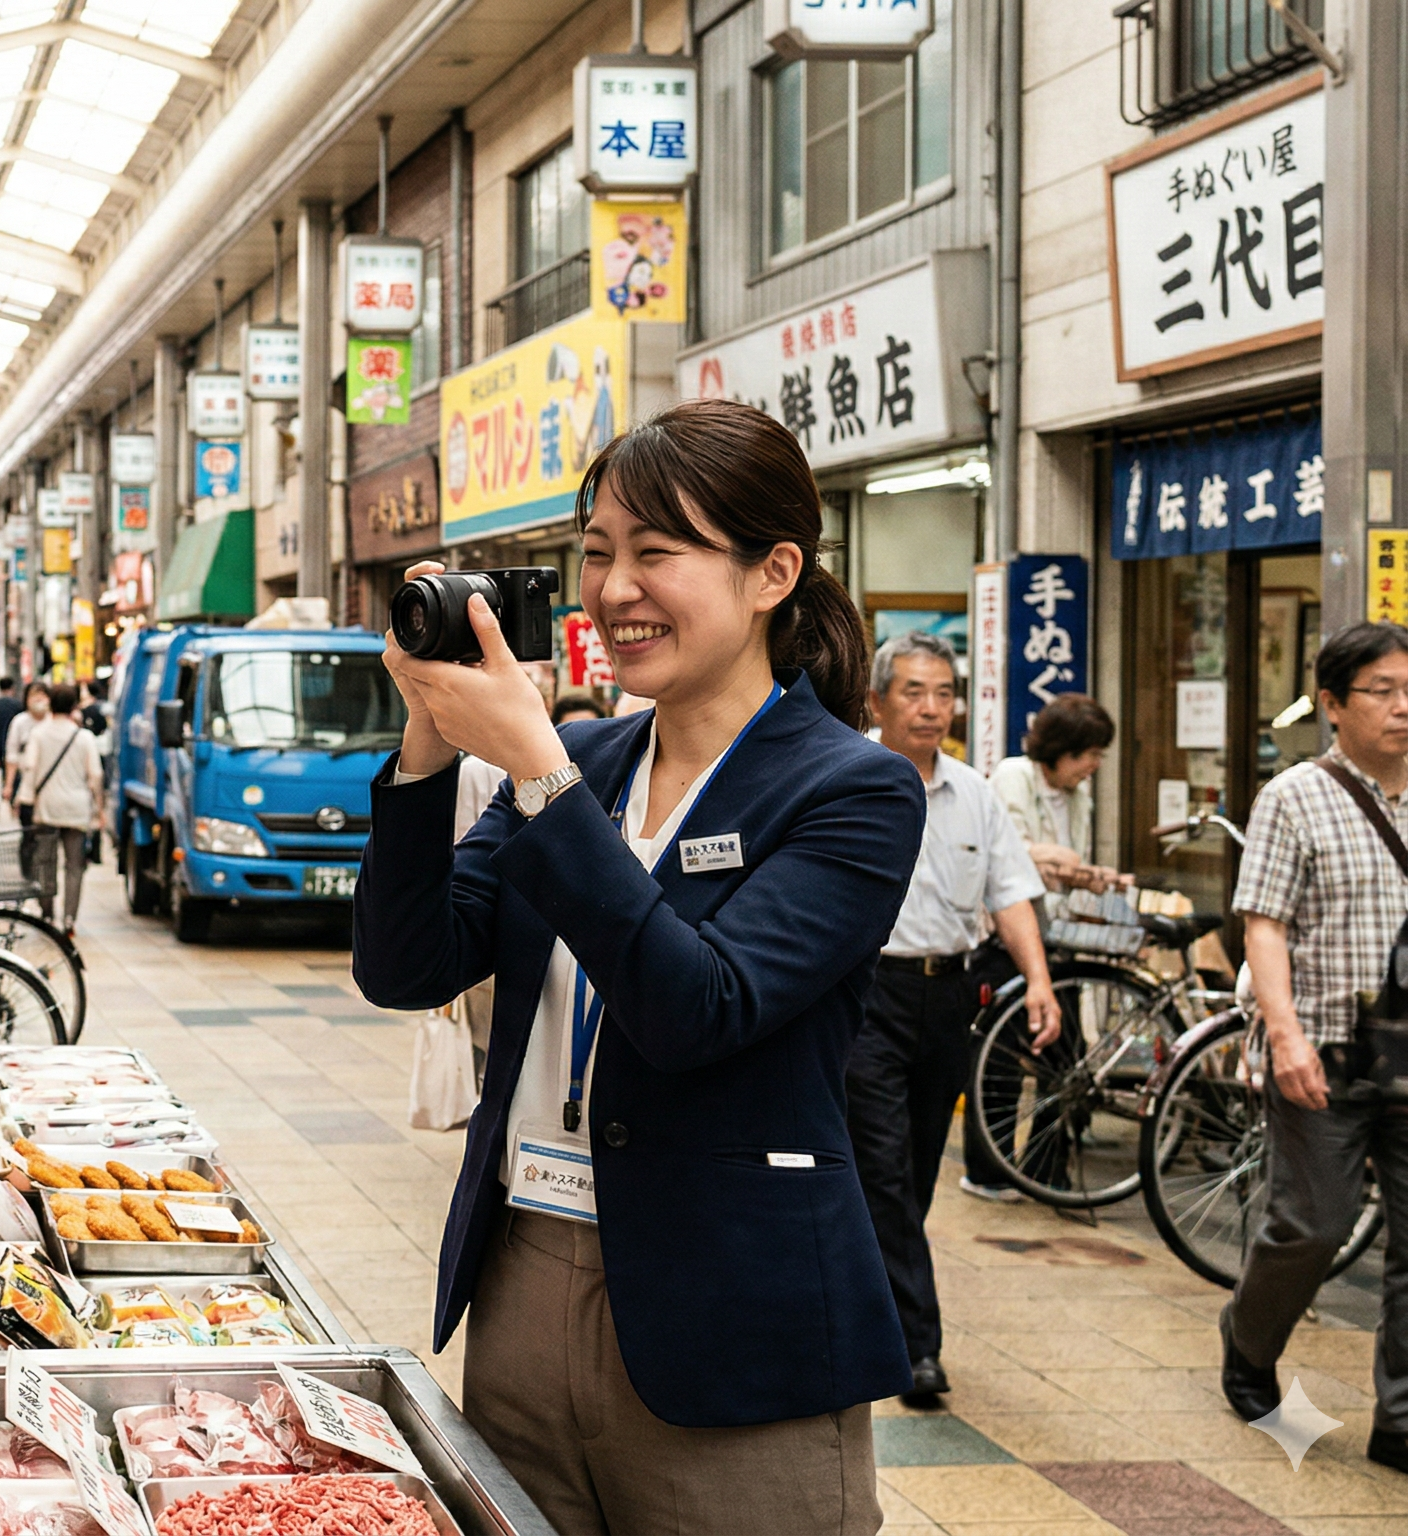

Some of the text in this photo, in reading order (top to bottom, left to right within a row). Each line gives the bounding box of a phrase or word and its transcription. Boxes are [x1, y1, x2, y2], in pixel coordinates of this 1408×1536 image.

[600, 120, 687, 158] 本屋
[1167, 124, 1297, 213] 手ぬぐい屋
[355, 281, 414, 311] 薬局
[1154, 182, 1324, 334] 三代目
[1157, 455, 1326, 533] 伝統工芸
[1022, 563, 1075, 753] 手ぬぐ
